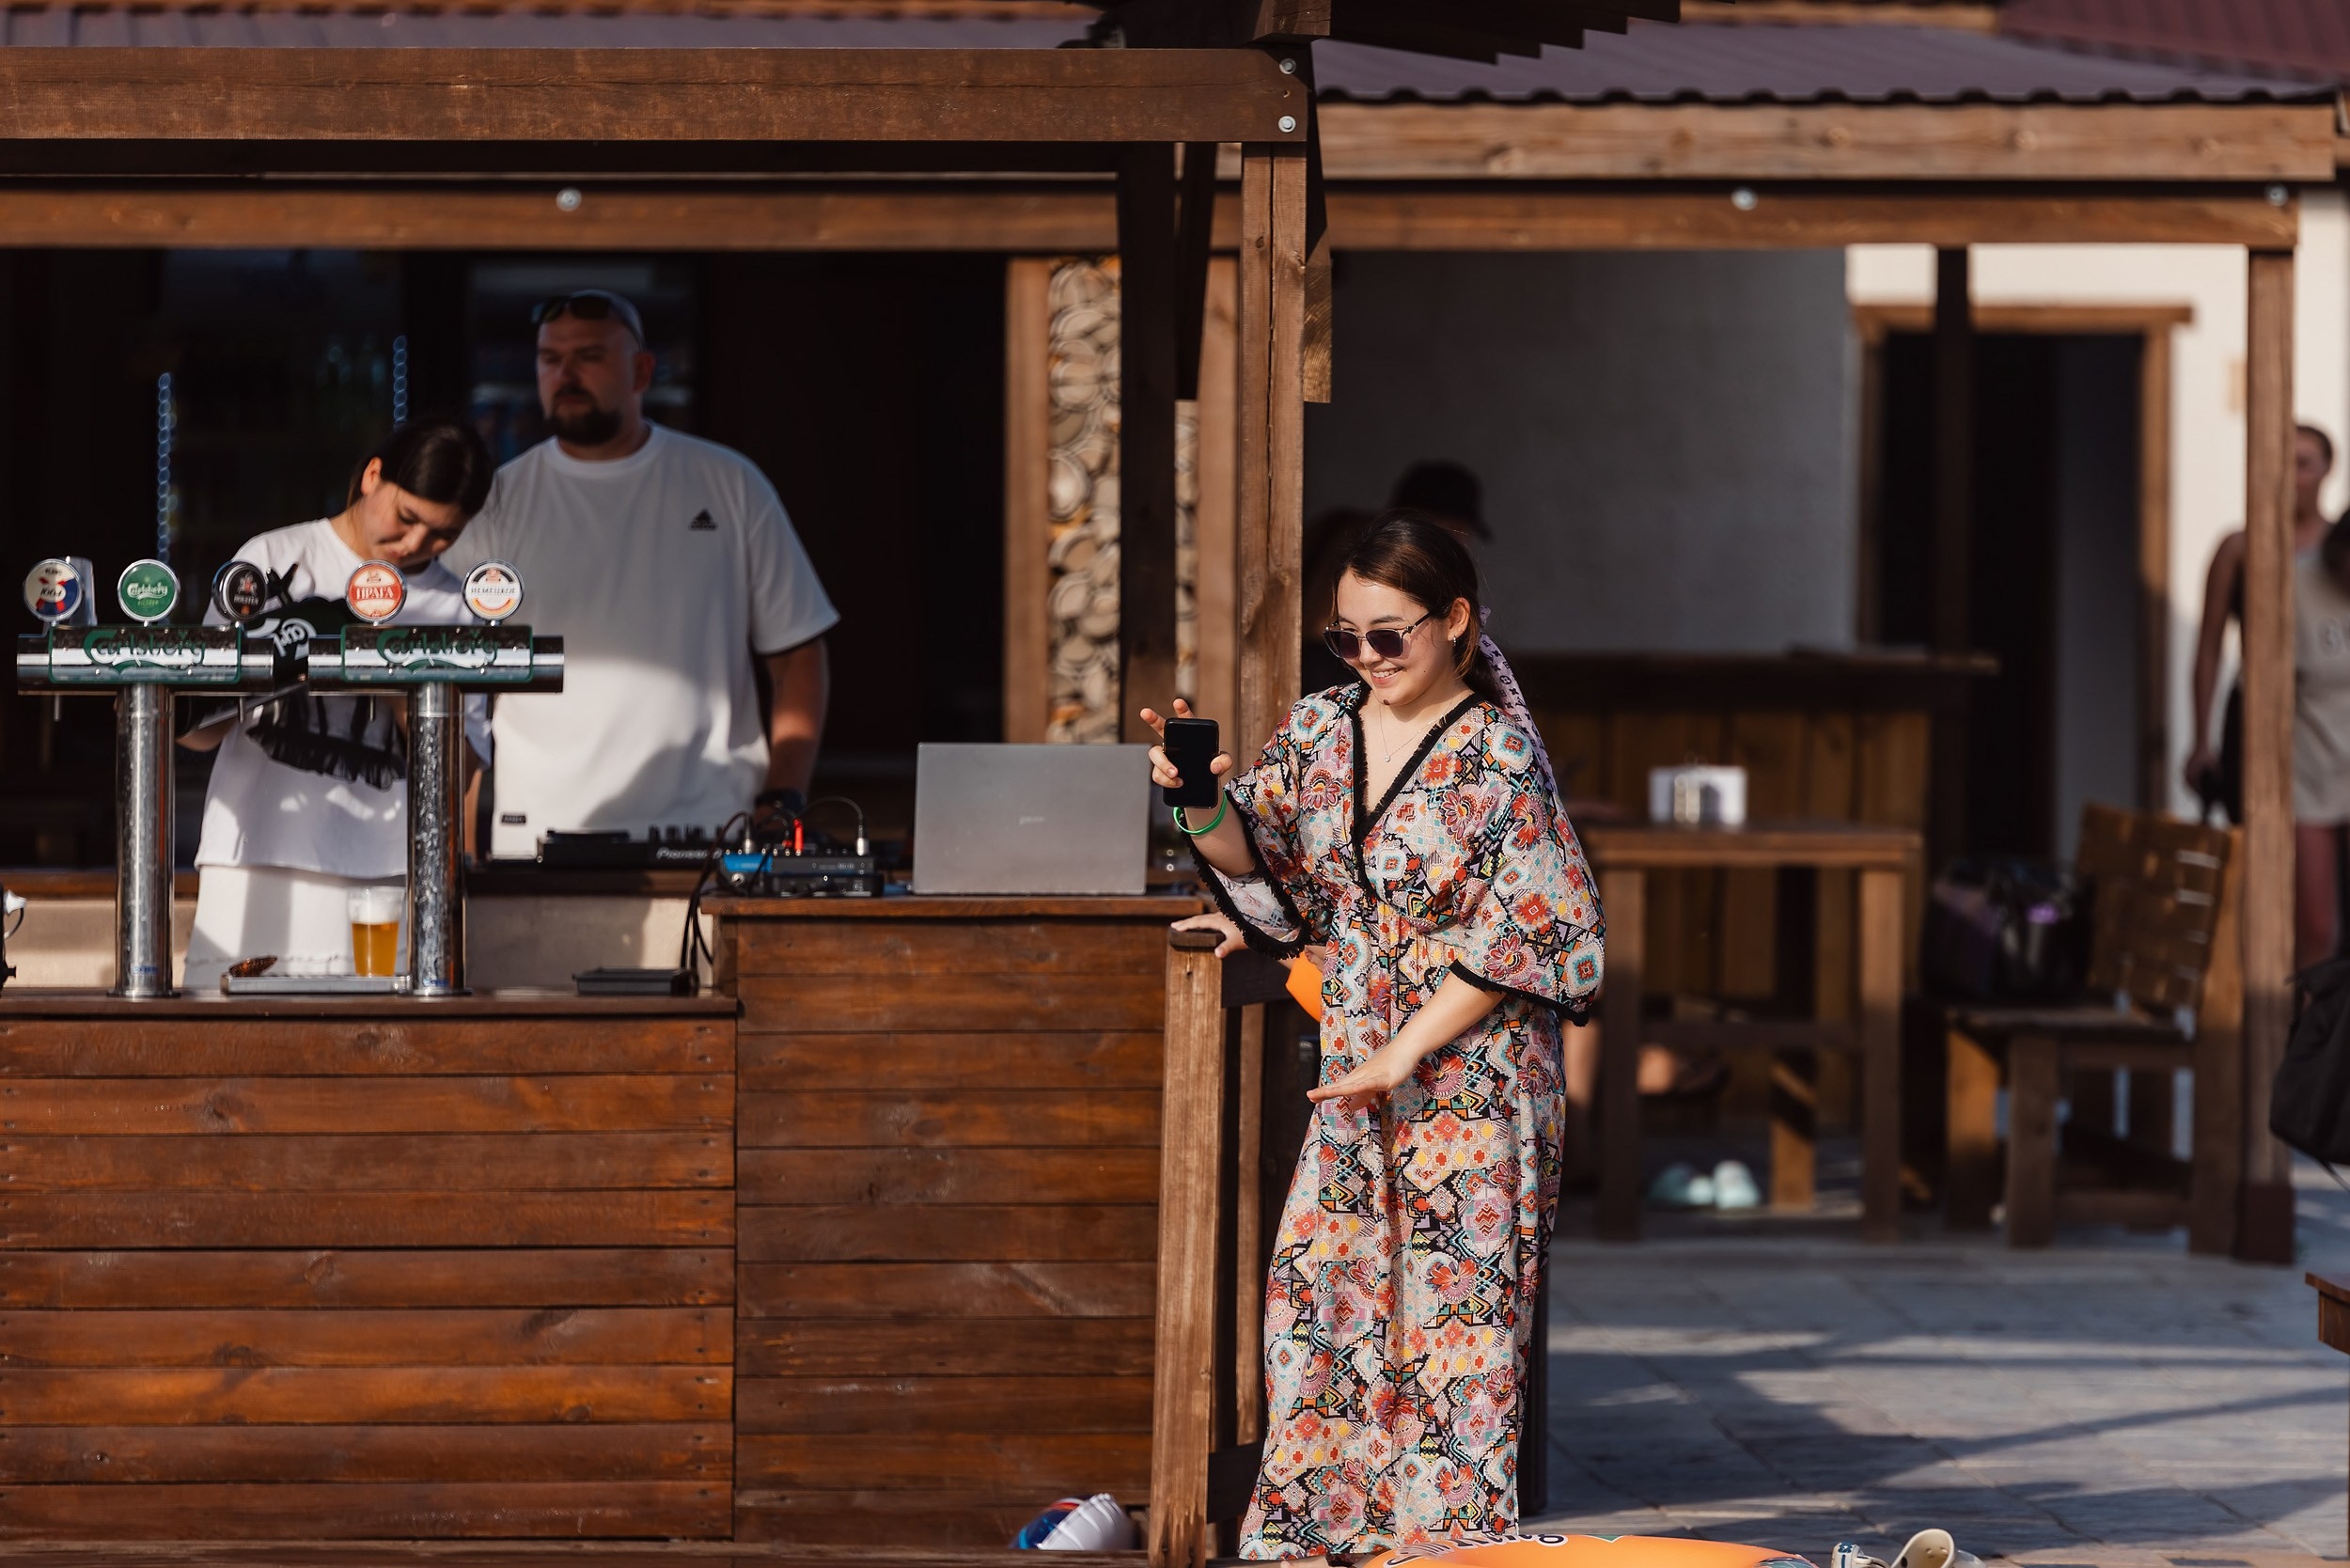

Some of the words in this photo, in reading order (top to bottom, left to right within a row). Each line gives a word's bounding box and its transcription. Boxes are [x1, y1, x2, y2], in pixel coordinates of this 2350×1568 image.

[127, 581, 168, 601] Carlsberg
[356, 587, 394, 600] ПРАГА
[84, 629, 206, 673] Carlsberg
[376, 628, 501, 673] Carlsberg
[656, 847, 708, 859] Pioneer
